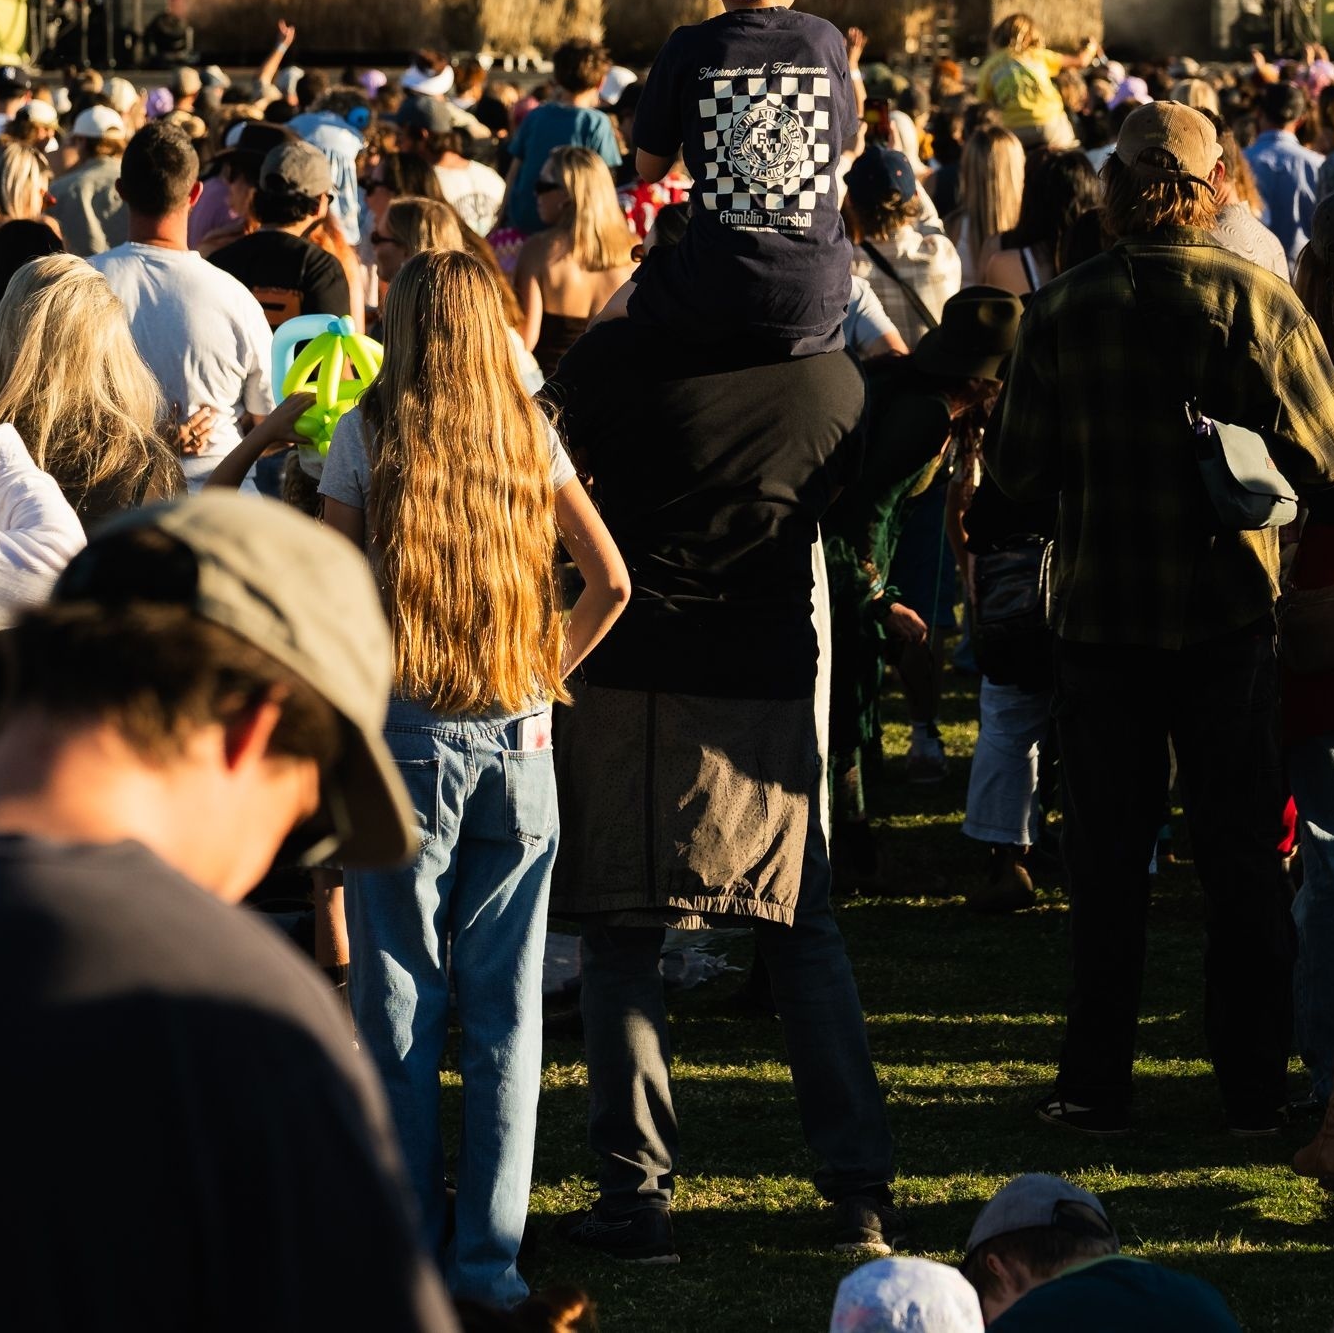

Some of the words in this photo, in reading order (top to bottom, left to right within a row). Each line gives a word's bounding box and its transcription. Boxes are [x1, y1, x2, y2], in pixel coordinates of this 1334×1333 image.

[698, 62, 767, 81] International
[771, 61, 828, 76] Tournament
[719, 209, 764, 225] Franklin
[767, 210, 812, 228] Marshall
